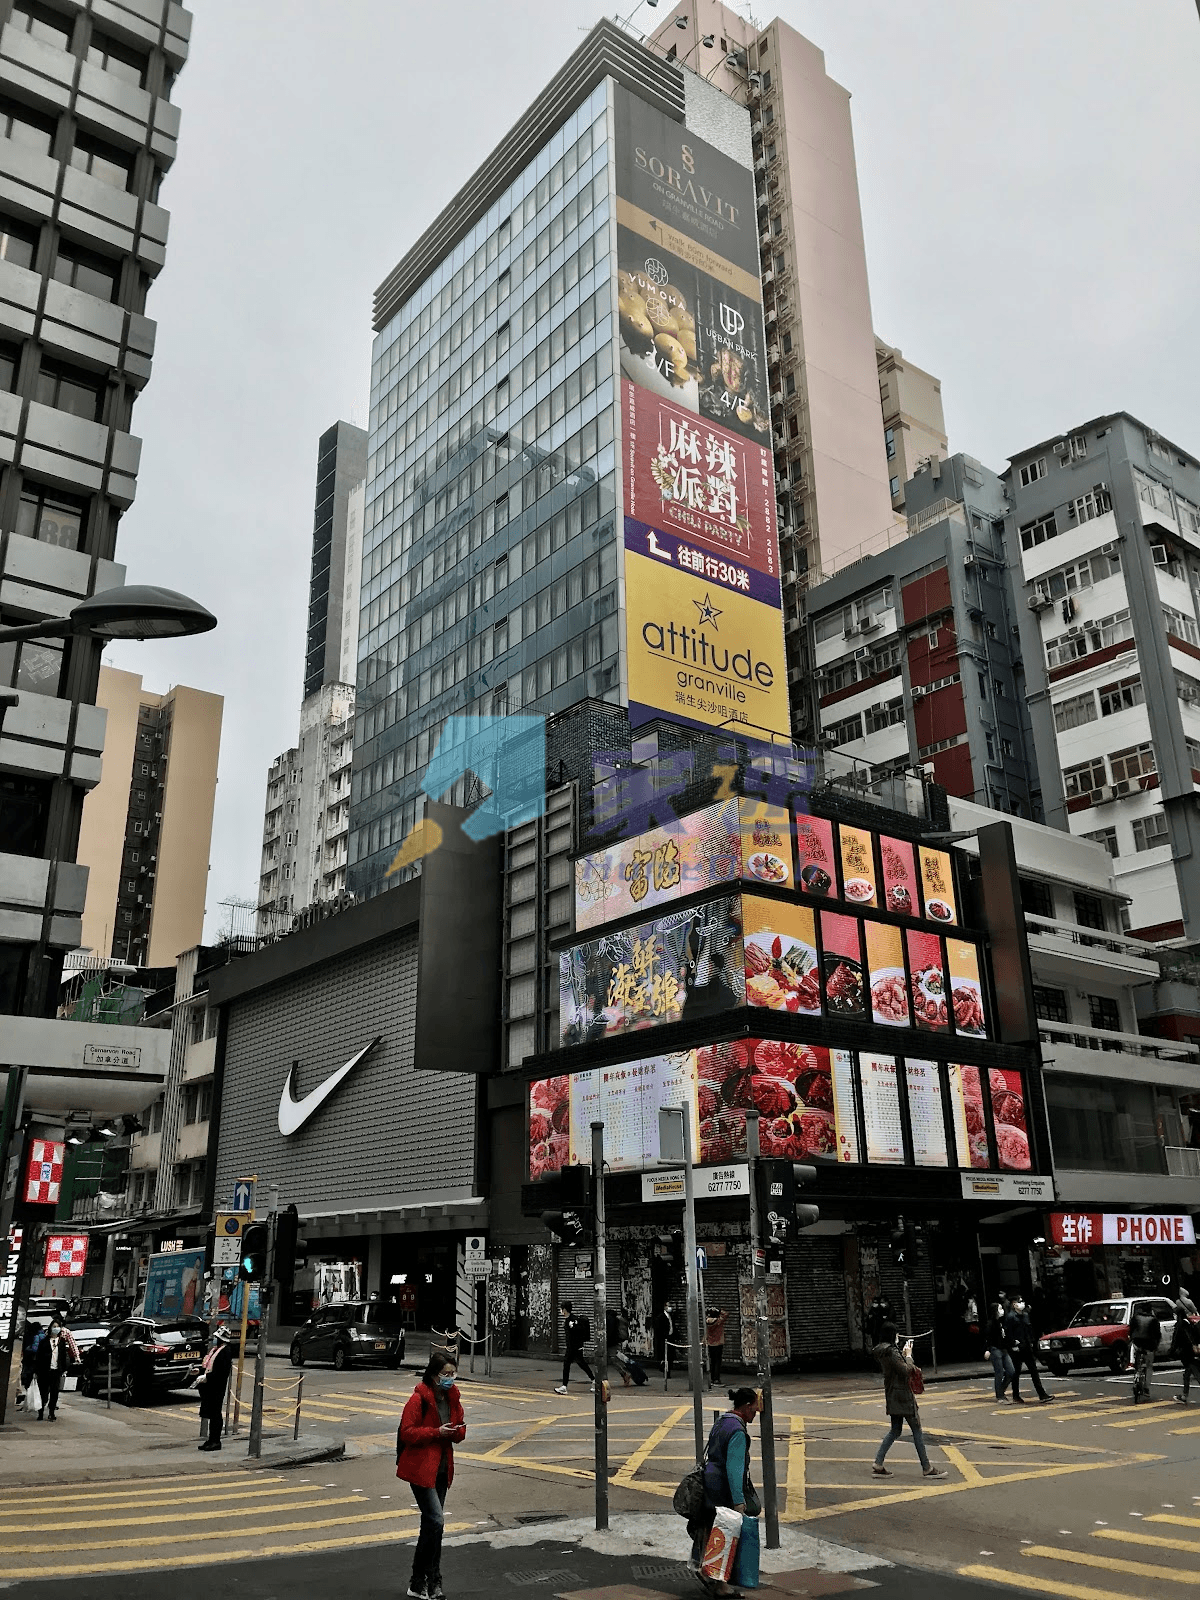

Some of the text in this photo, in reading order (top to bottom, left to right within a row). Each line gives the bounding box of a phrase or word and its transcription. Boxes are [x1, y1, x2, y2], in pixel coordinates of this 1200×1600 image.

[635, 147, 739, 224] SORAVIT
[665, 190, 703, 218] GRANVILLE
[628, 272, 686, 311] YUMOHA
[705, 328, 734, 350] URBAN
[669, 418, 739, 481] 麻辣
[669, 465, 740, 524] 派對
[677, 545, 750, 590] 往前行30米
[642, 621, 774, 687] attitude
[676, 671, 746, 703] granville
[708, 1180, 742, 1192] 6277 7750
[1062, 1214, 1093, 1243] 生作
[1116, 1216, 1185, 1242] PHONE
[160, 1240, 176, 1252] LUSH
